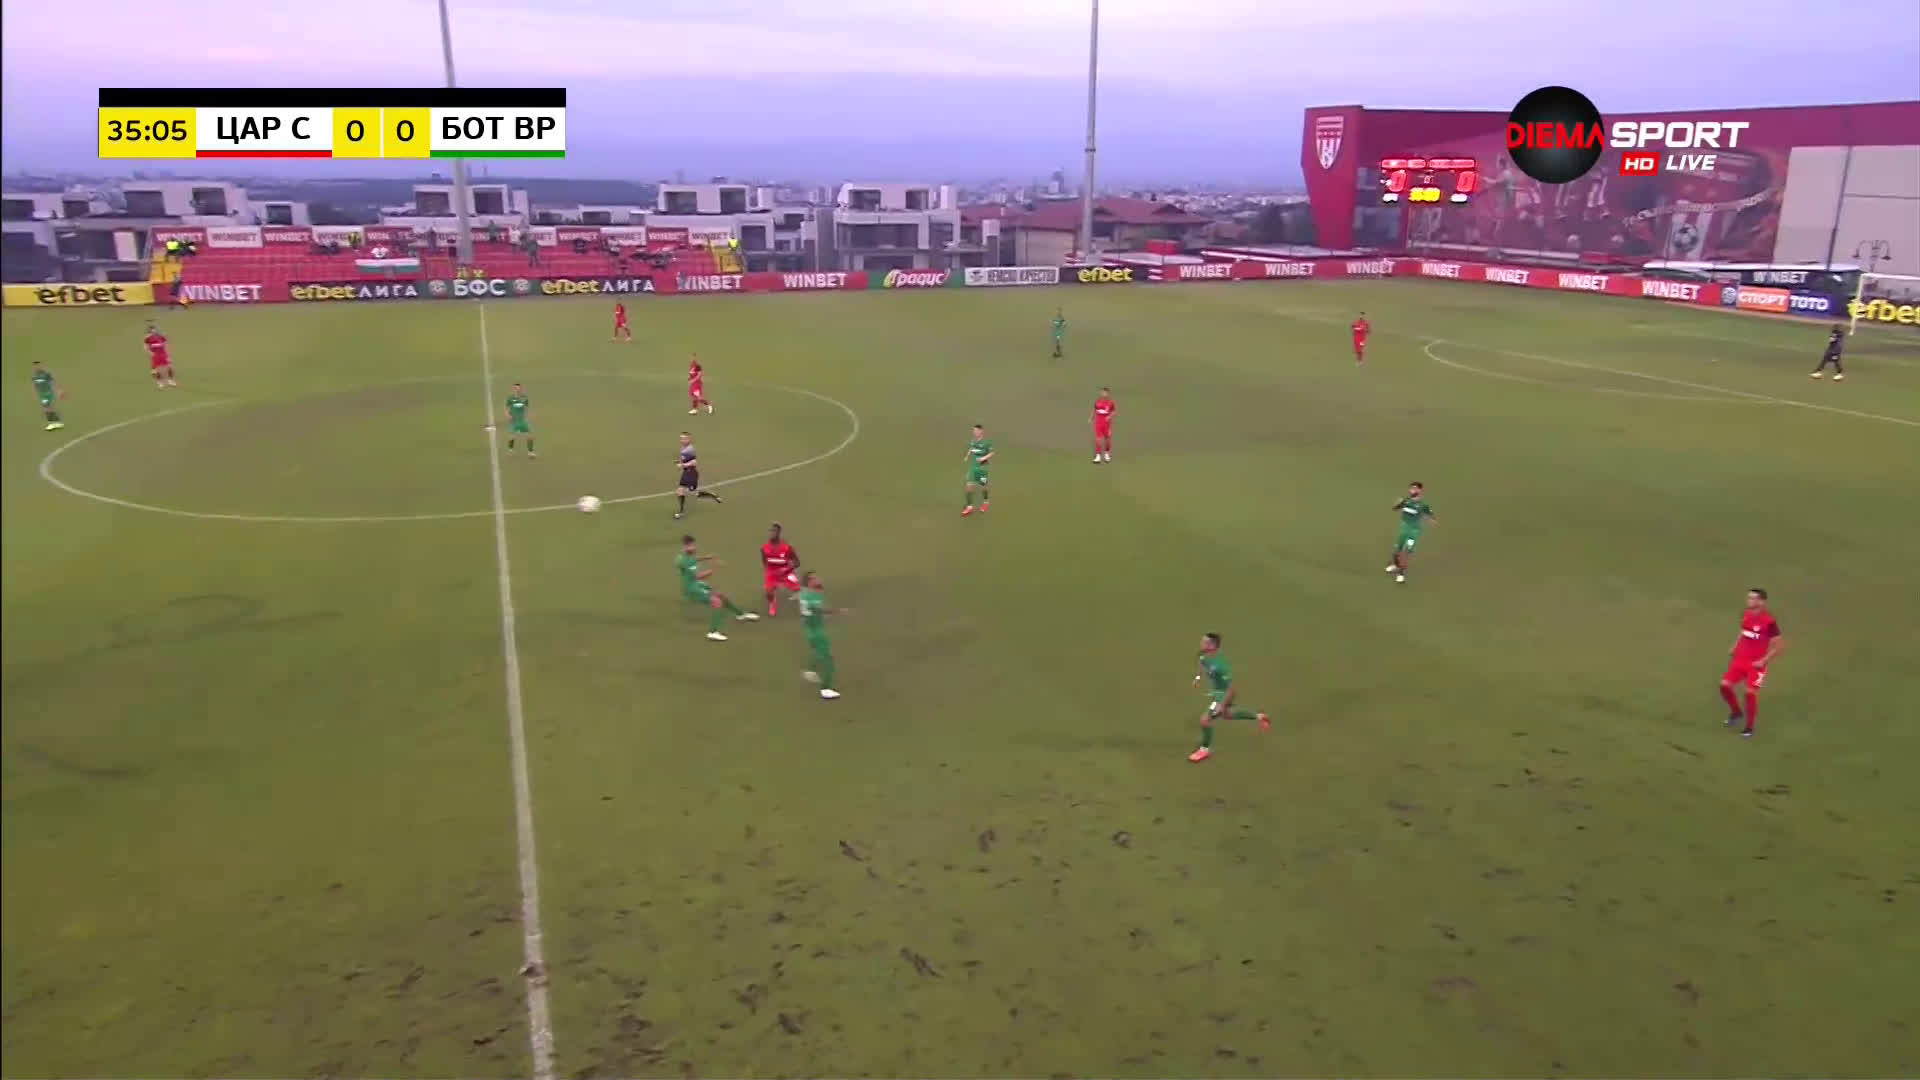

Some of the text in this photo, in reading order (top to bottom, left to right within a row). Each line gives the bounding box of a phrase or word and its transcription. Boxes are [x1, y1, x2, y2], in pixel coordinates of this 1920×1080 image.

[1077, 266, 1134, 282] efbet
[1179, 264, 1232, 278] WINBET
[1265, 263, 1315, 277] WINBET
[1346, 261, 1395, 275] WINBET
[1421, 263, 1462, 278] WINBET
[1485, 267, 1530, 284] WINBET
[676, 274, 744, 291] WINBET
[783, 272, 847, 288] WINBET
[1558, 273, 1609, 291] WINBET
[1753, 271, 1809, 284] WNBET
[36, 285, 127, 303] efbet
[290, 284, 356, 299] efbet
[453, 278, 506, 297] БФС
[541, 279, 600, 294] efbet
[1642, 280, 1701, 301] WINBET
